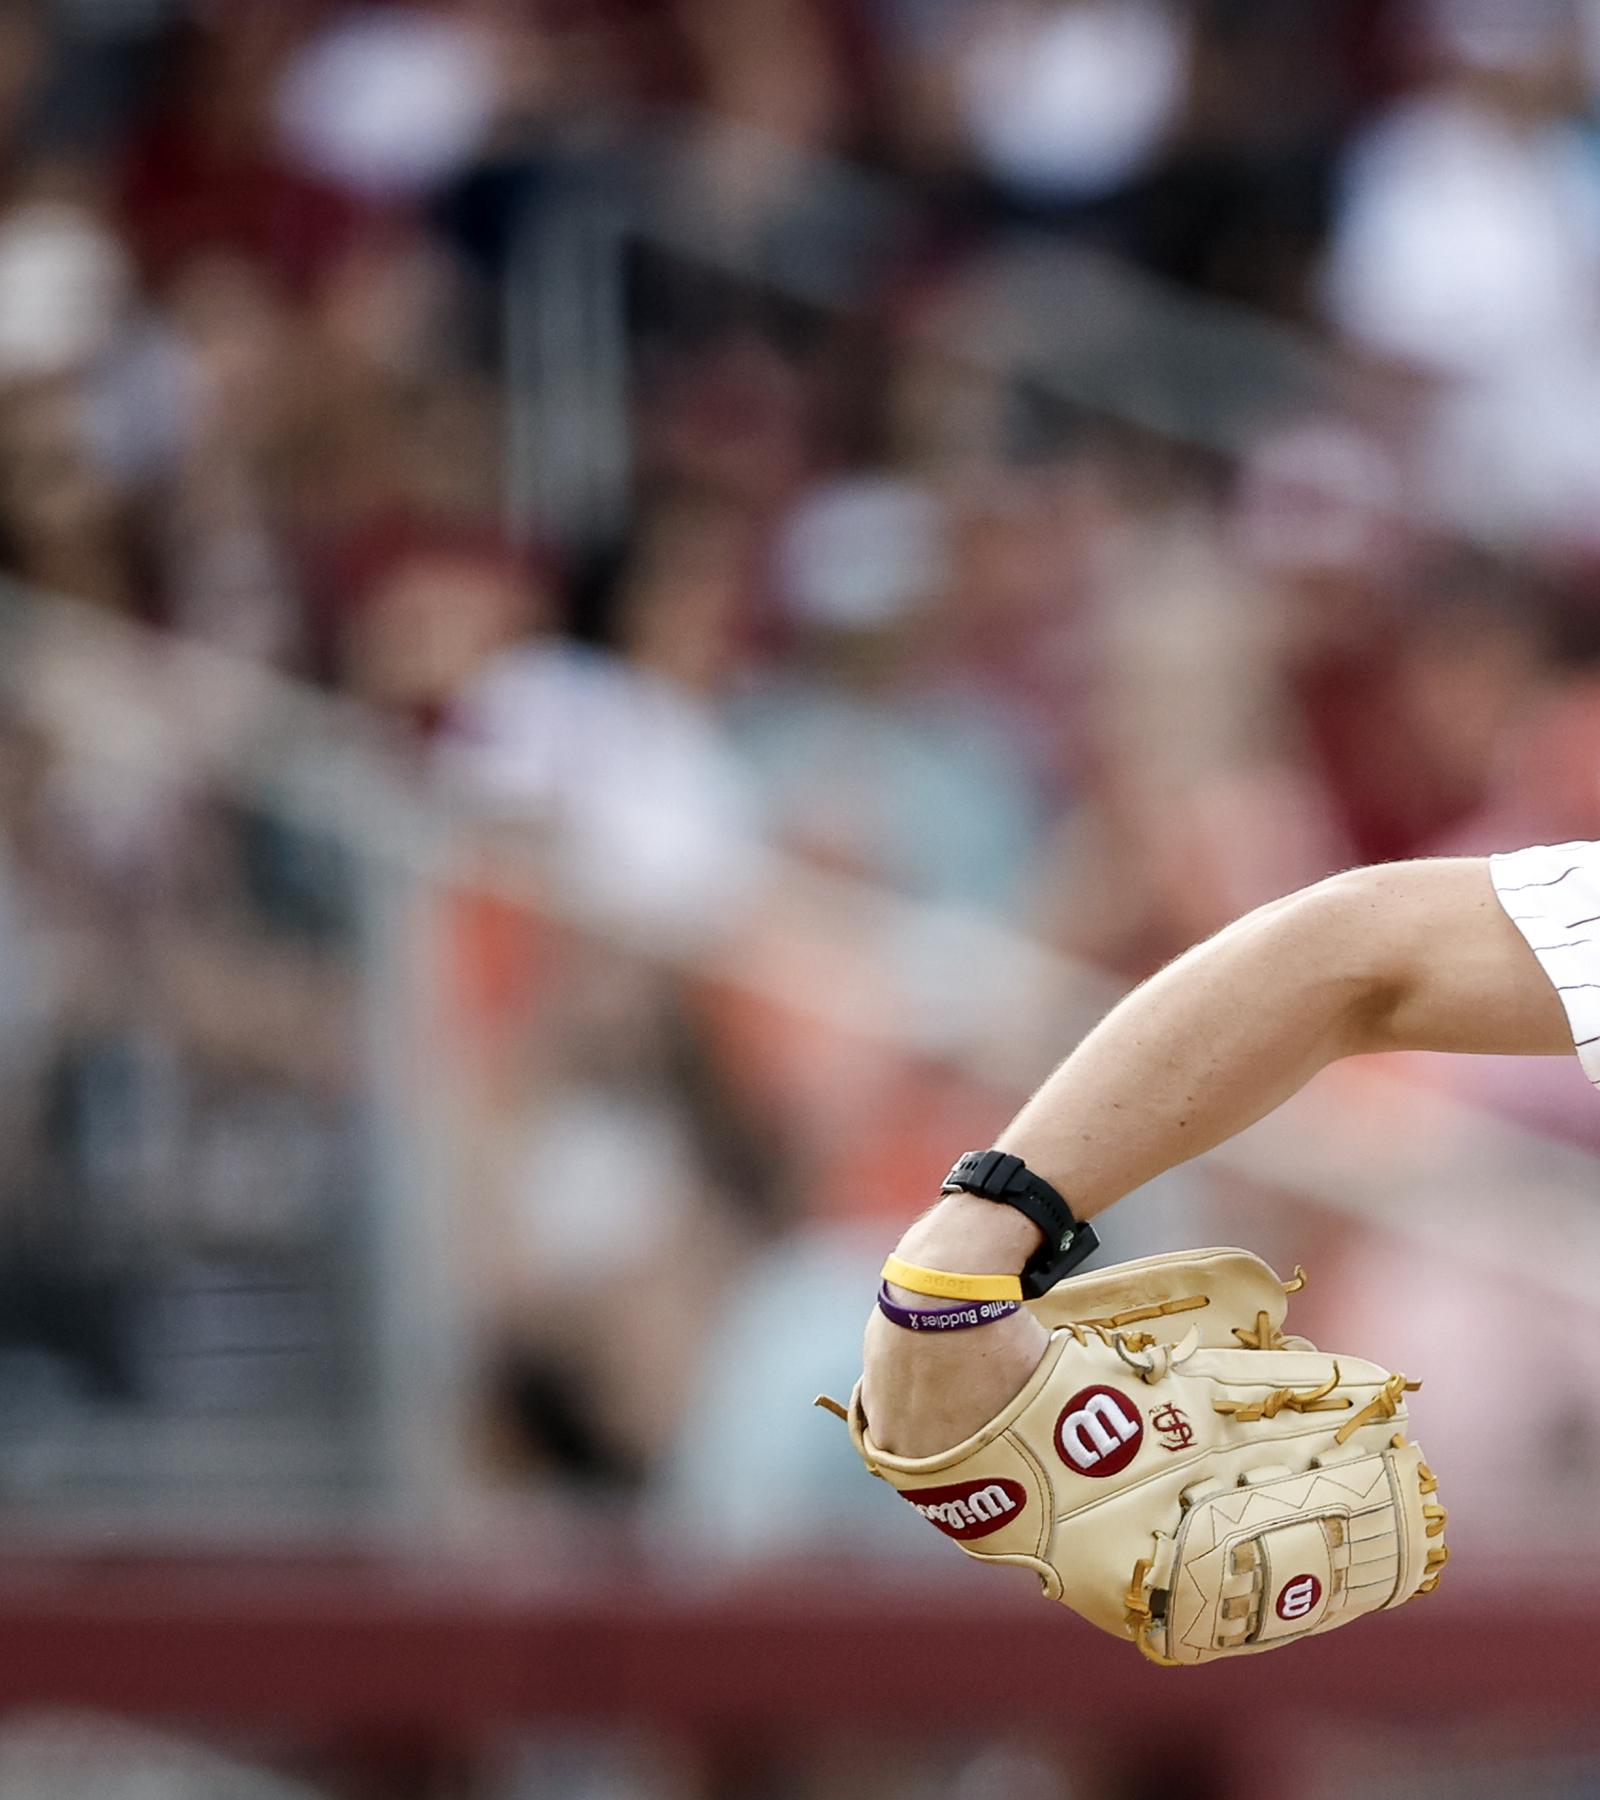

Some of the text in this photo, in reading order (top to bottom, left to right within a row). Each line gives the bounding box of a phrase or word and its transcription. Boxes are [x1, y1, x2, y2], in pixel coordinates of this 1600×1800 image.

[922, 1307, 977, 1329] Buddies
[1061, 1393, 1140, 1469] W
[1282, 1577, 1313, 1617] W
